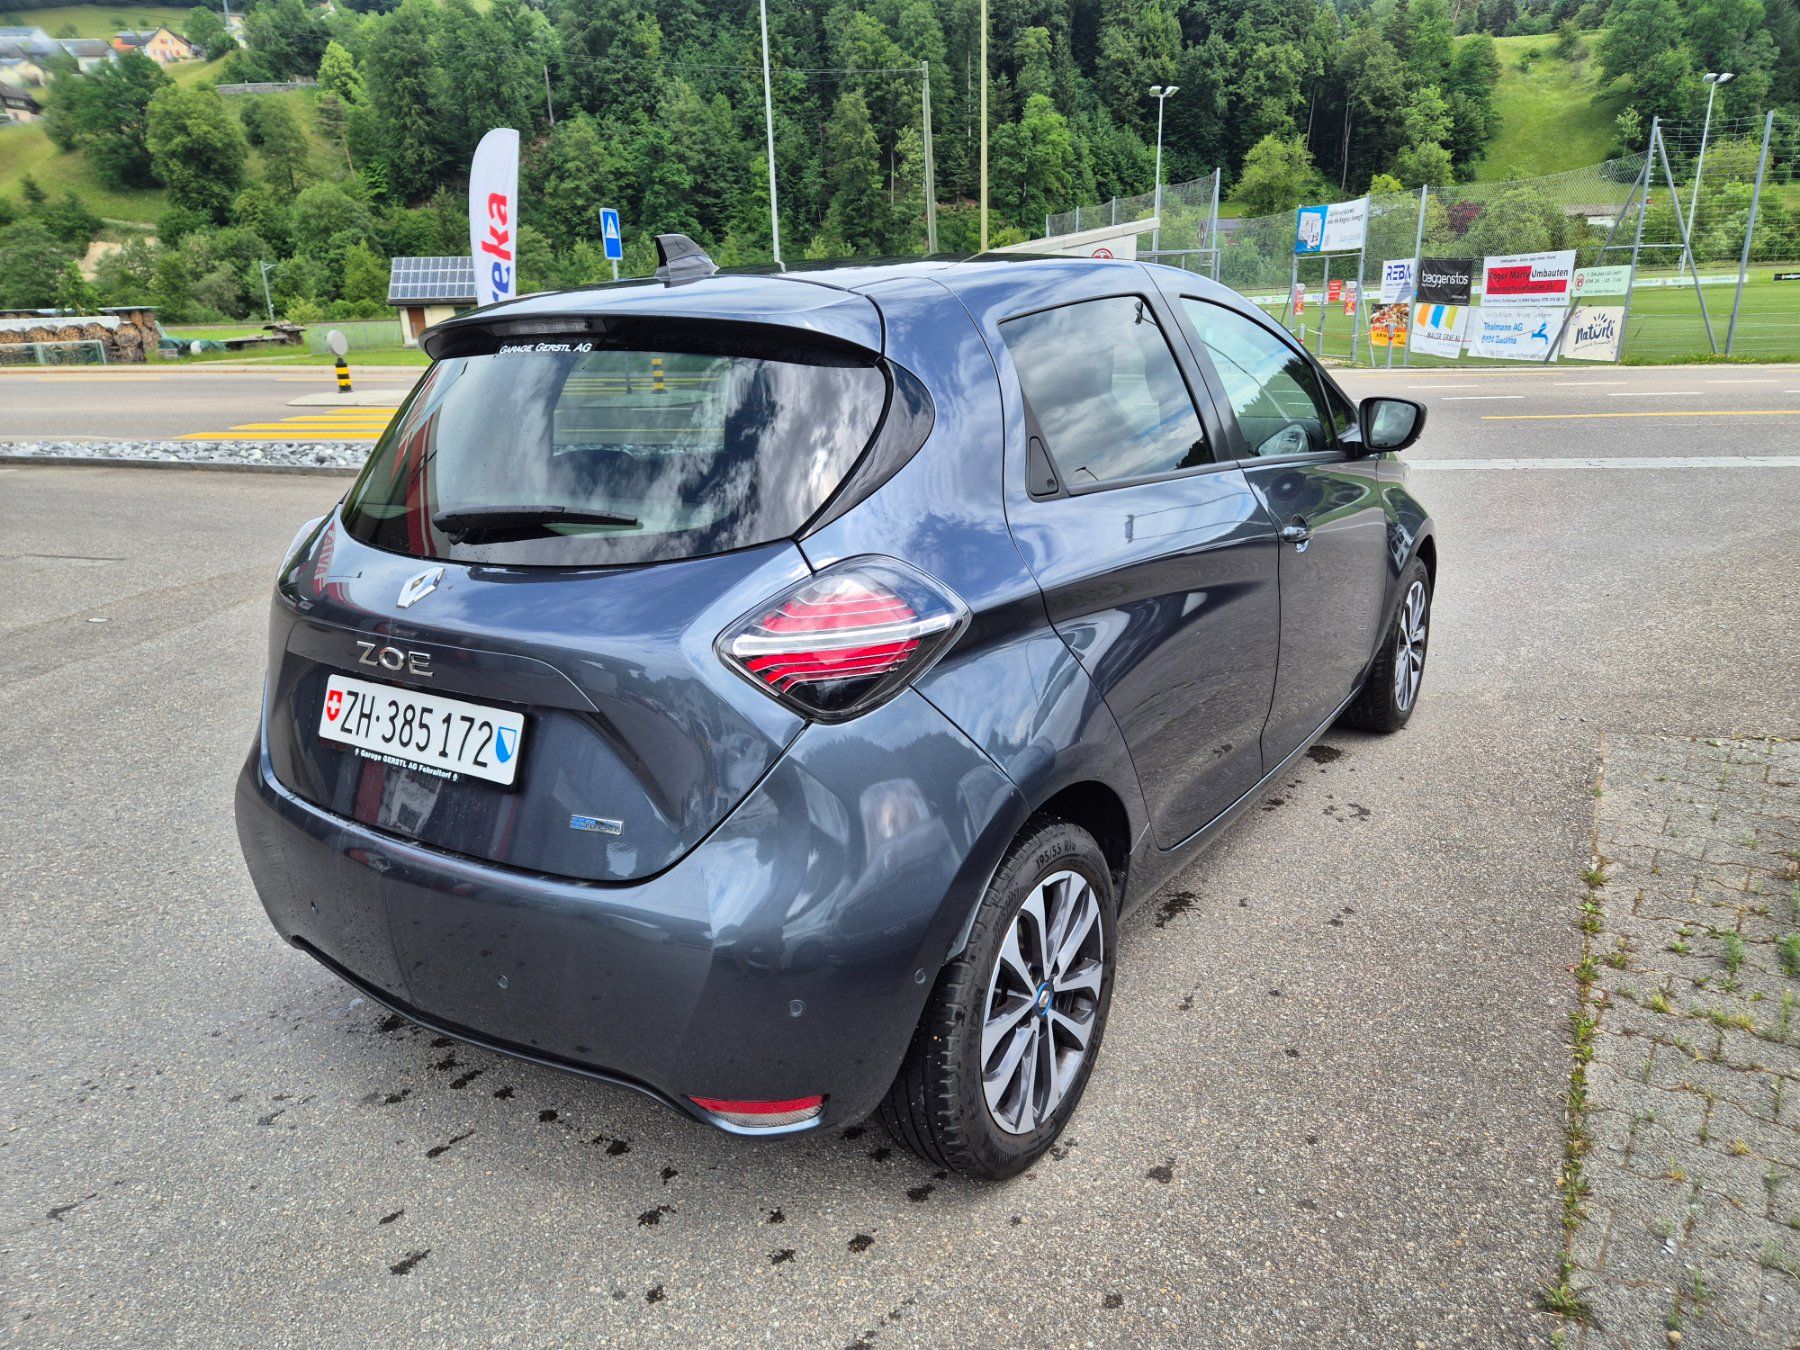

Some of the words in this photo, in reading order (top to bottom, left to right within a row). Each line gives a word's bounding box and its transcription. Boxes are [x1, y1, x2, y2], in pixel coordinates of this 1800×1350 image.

[1422, 270, 1469, 287] baggenstos
[1488, 271, 1507, 282] Roger
[1509, 270, 1531, 281] Marty
[1531, 268, 1569, 278] Umbauten
[1513, 322, 1523, 331] AG
[500, 345, 534, 354] GARAGE
[535, 342, 571, 352] GERSTL
[573, 342, 593, 352] AG
[356, 640, 435, 677] ZOE
[360, 749, 382, 761] Garage
[382, 755, 407, 768] GERSTL
[408, 762, 418, 770] AG
